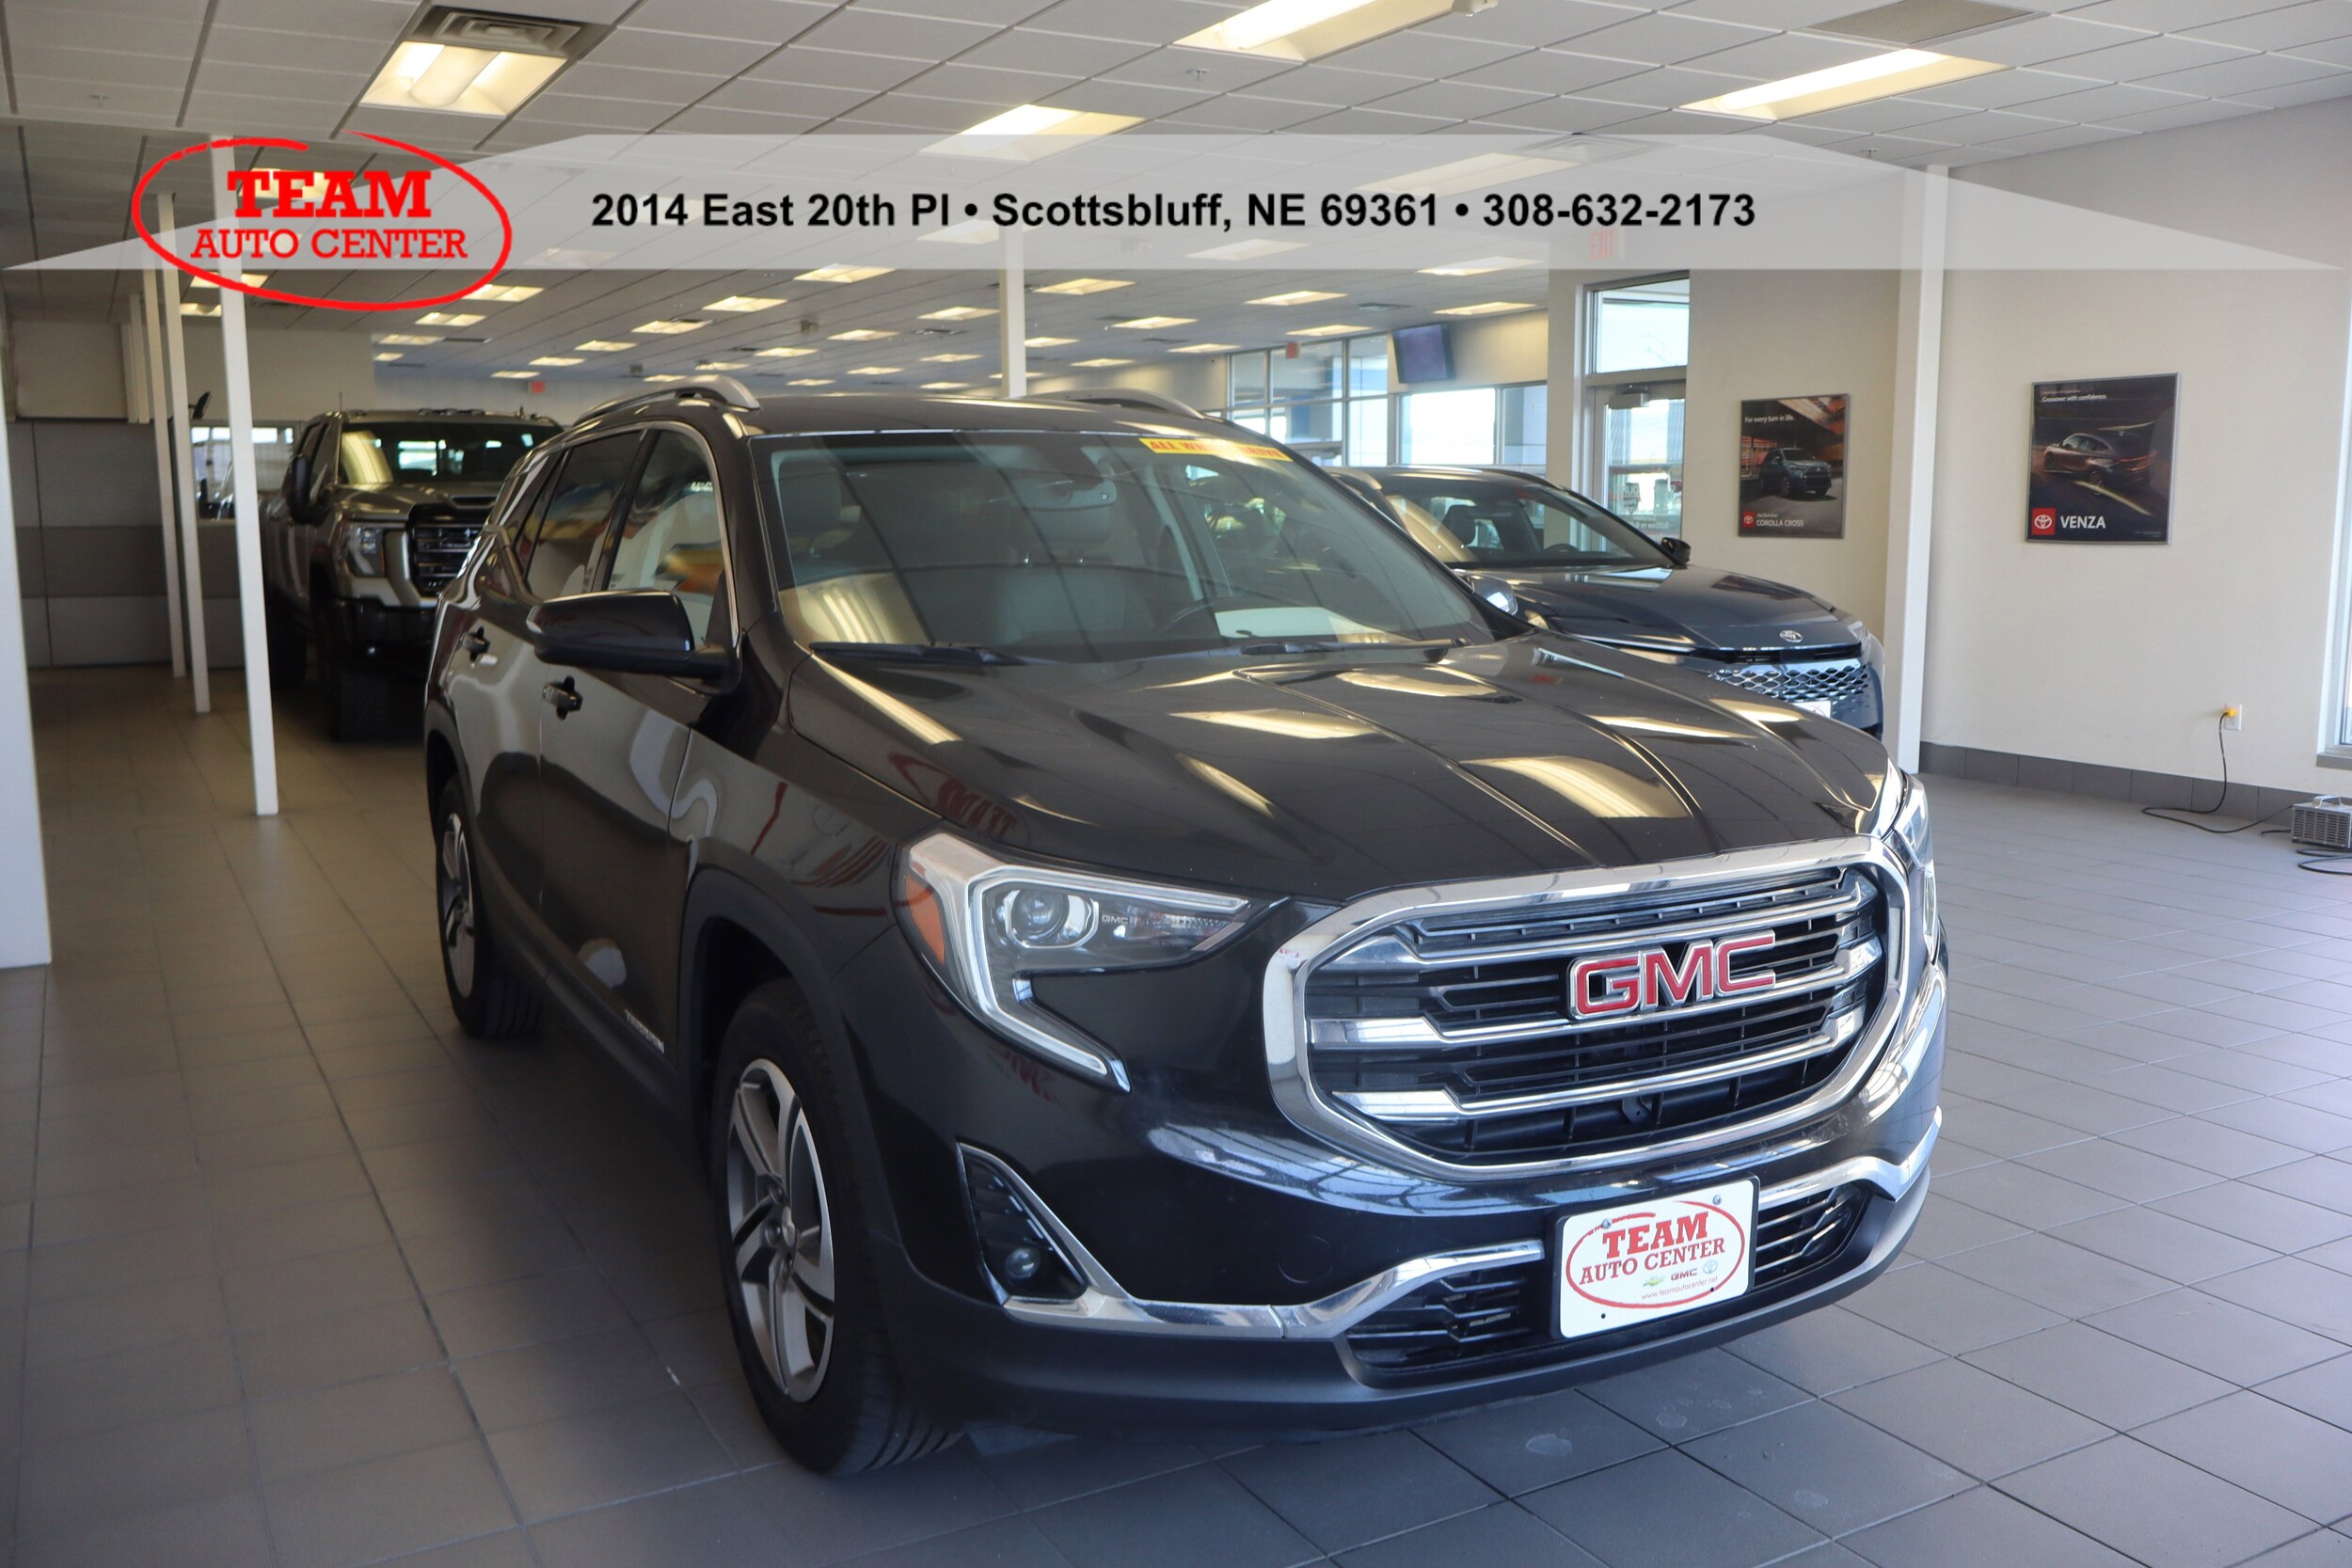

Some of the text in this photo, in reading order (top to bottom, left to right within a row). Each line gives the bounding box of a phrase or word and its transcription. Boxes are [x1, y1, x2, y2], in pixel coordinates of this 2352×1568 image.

[1149, 439, 1175, 451] ALL
[1784, 518, 1804, 527] CROSS
[2059, 515, 2106, 530] VENZA
[1102, 913, 1129, 925] GMC
[1569, 929, 1776, 1020] GMC
[1602, 1211, 1709, 1259] TEAM
[1579, 1237, 1725, 1286] AUTO CENTER
[1670, 1267, 1698, 1281] GMC
[1641, 1275, 1719, 1300] www.teamautocenter.net
